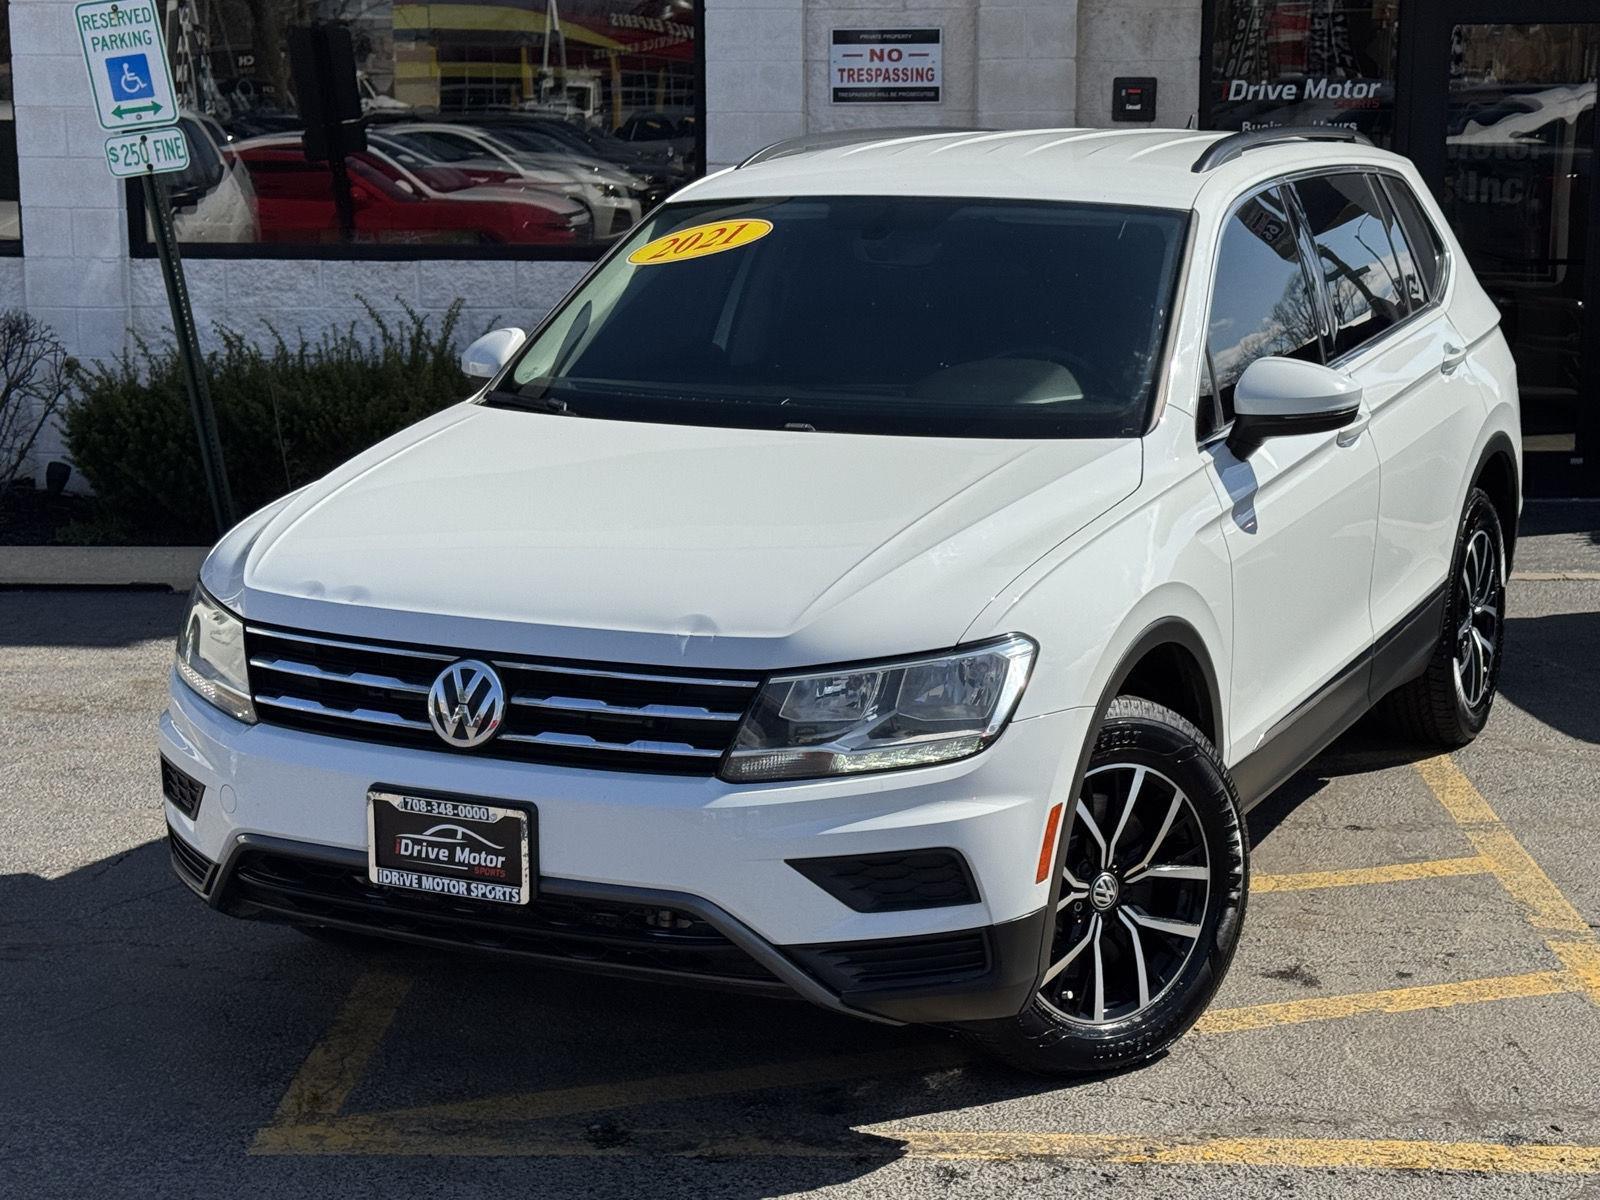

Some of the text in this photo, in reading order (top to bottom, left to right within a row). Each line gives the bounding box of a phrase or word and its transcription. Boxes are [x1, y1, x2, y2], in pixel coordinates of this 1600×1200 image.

[81, 7, 152, 31] RESERVED
[91, 30, 152, 52] PARKING
[869, 48, 903, 62] NO
[838, 67, 935, 83] TRESPASSING
[1304, 78, 1382, 99] Motor
[109, 137, 185, 167] $250 FINE
[647, 223, 749, 260] 2021
[406, 798, 488, 820] 708-348-0000
[394, 838, 506, 868] iDrive Motor
[474, 866, 506, 877] SPORTS
[421, 875, 467, 895] MOTOR
[470, 883, 520, 902] SPORTS
